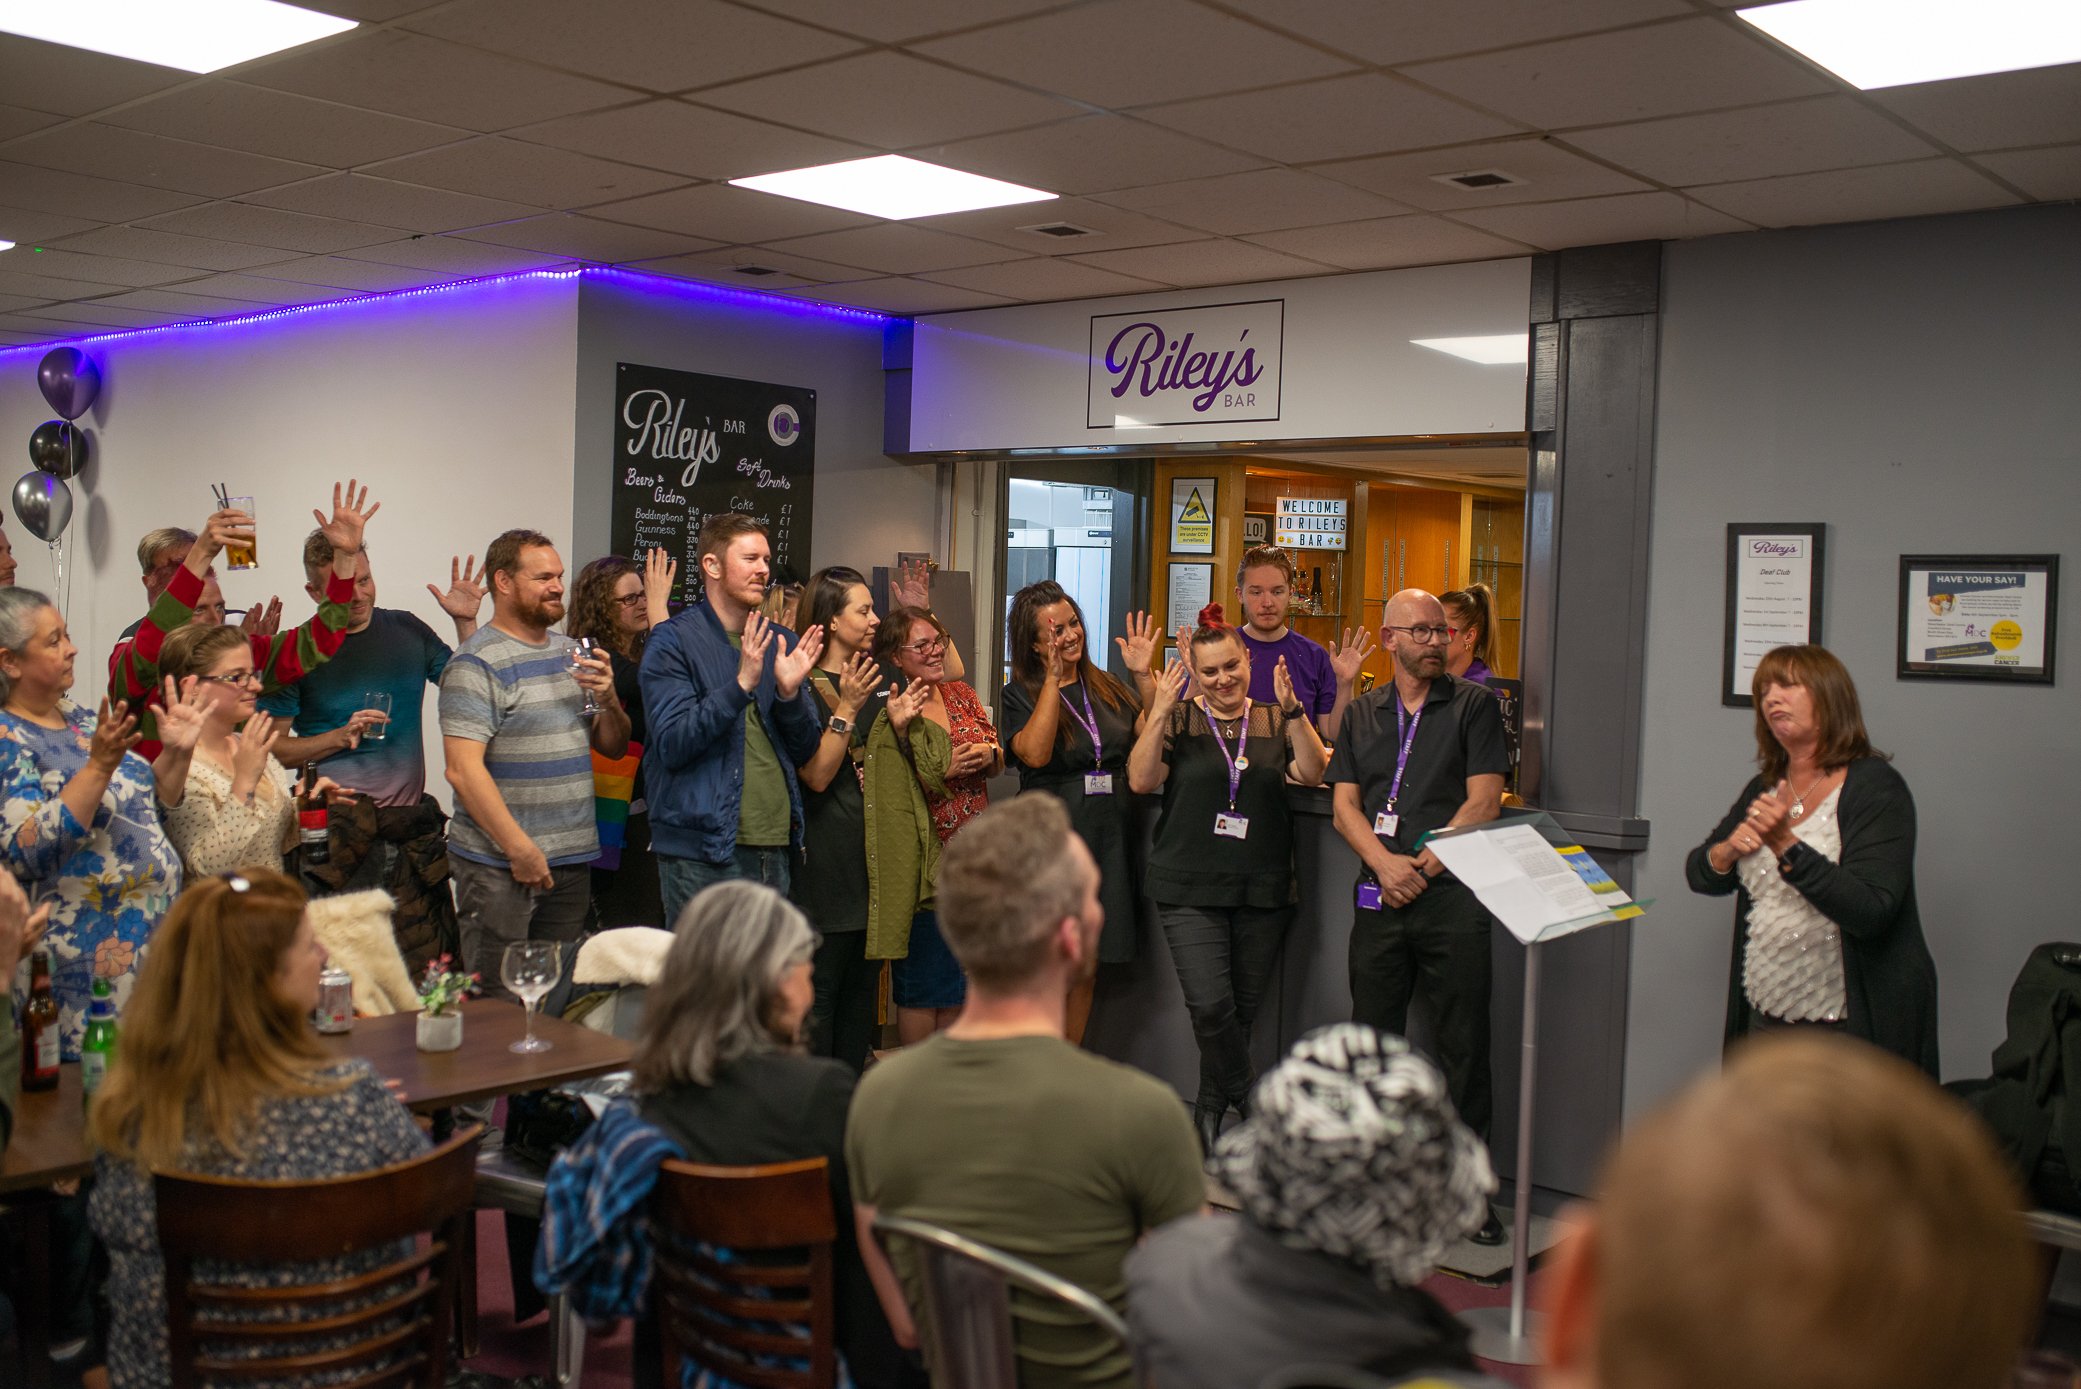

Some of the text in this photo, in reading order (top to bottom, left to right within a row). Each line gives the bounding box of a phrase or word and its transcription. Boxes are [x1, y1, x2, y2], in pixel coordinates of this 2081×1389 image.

[1105, 322, 1264, 412] Riley's
[1224, 393, 1256, 408] BAR
[623, 389, 746, 487] Riley's BAR
[736, 458, 762, 476] Soft
[625, 467, 664, 487] Beers &
[757, 469, 791, 489] Drinks
[654, 486, 686, 505] Ciders
[730, 496, 792, 514] Coke £1
[1283, 500, 1339, 513] WELCOME
[635, 507, 684, 524] Boddingtons
[779, 516, 791, 527] £1
[635, 520, 676, 535] Guinness
[1243, 522, 1263, 537] LO!
[1279, 517, 1346, 530] TO RILEYS
[634, 532, 699, 547] Peroni 330
[777, 529, 789, 540] £1
[1299, 534, 1323, 546] BAR
[777, 541, 788, 552] £1
[1753, 541, 1798, 556] Riley's
[776, 555, 788, 565] £1
[685, 564, 699, 573] 330
[685, 577, 697, 585] 500
[1936, 575, 2017, 584] HAVE YOUR SAY!
[684, 594, 697, 602] 500
